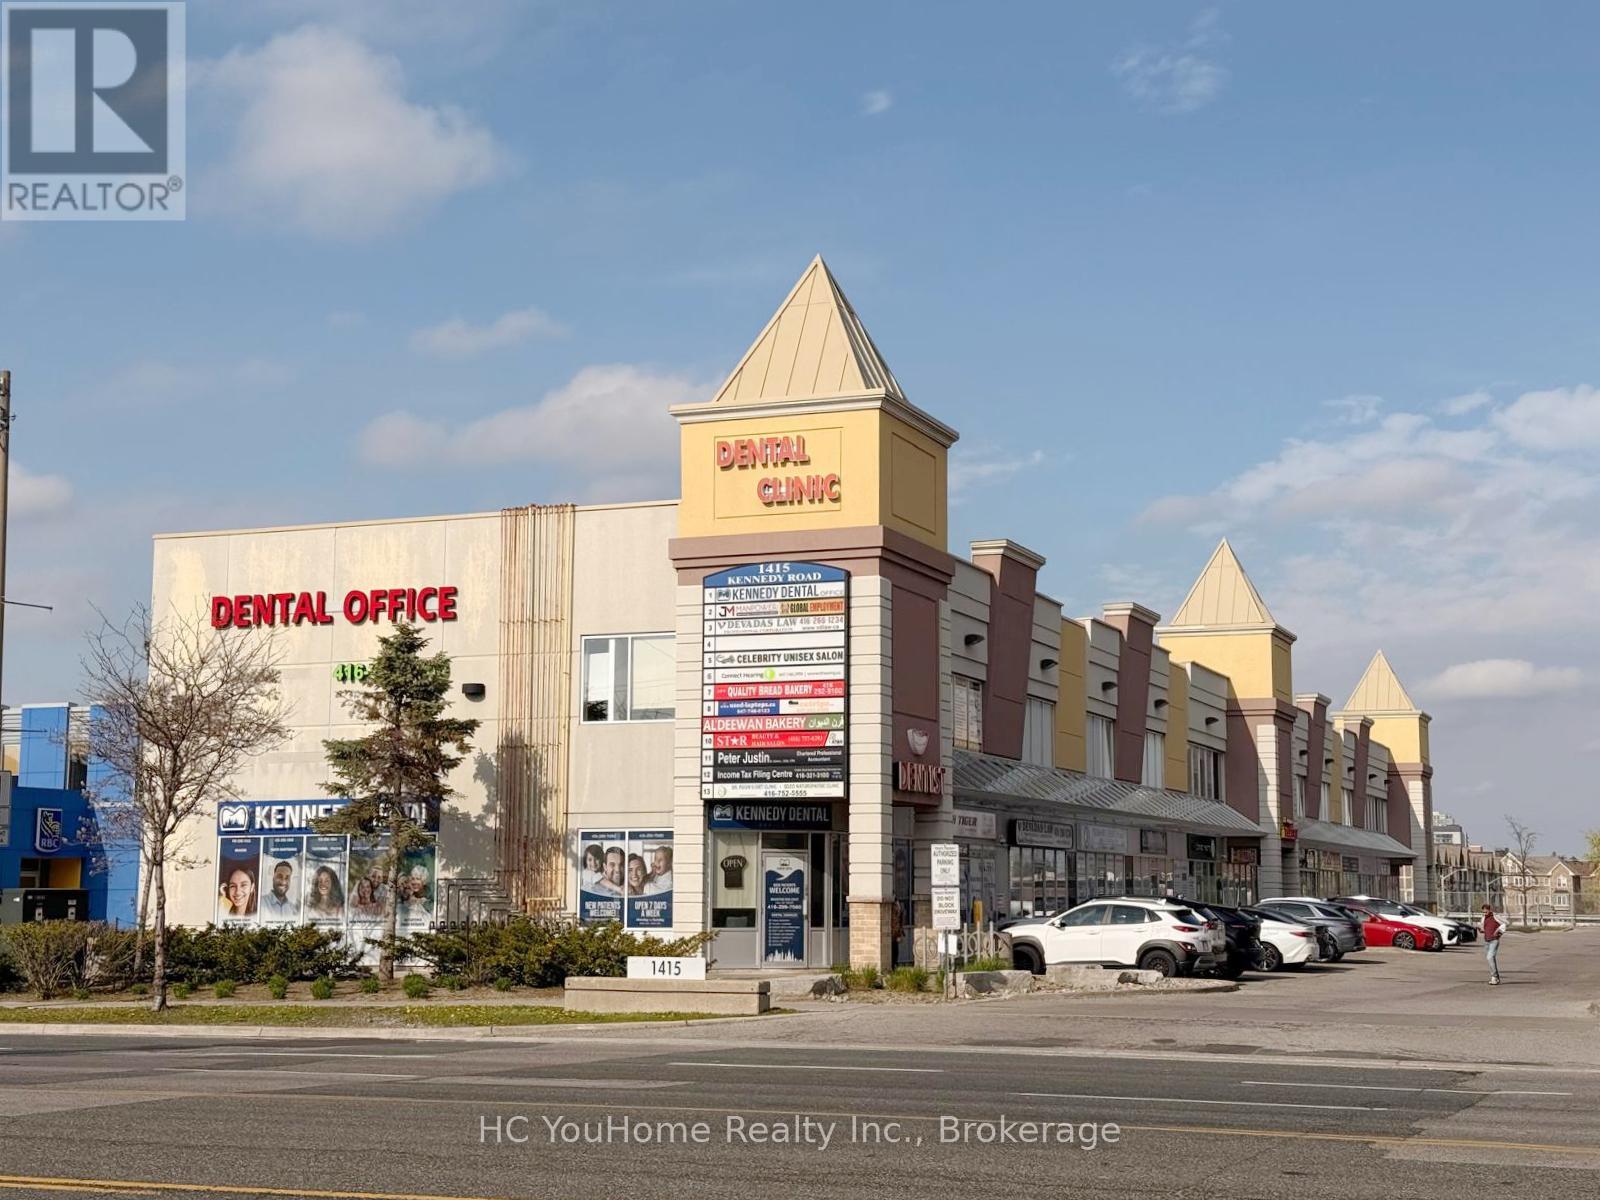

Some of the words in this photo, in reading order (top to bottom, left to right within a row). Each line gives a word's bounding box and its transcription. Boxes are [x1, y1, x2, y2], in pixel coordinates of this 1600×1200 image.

[717, 435, 810, 469] DENTAL
[757, 473, 840, 505] CLINIC
[759, 563, 790, 573] 1415
[727, 574, 786, 585] KENNEDY
[788, 572, 822, 581] ROAD
[732, 586, 779, 600] KENNEDY
[781, 585, 819, 598] DENTAL
[211, 591, 333, 630] DENTAL
[343, 586, 457, 625] OFFICE
[719, 606, 735, 617] JM
[727, 619, 773, 629] DEVADAS
[776, 618, 797, 628] LAW
[737, 653, 782, 664] CELEBRITY
[784, 652, 814, 662] UNISEX
[816, 651, 844, 660] SALON
[727, 686, 756, 697] QUALITY
[759, 685, 782, 696] BREAD
[784, 684, 812, 695] BAKERY
[766, 717, 806, 729] BAKERY
[718, 752, 740, 763] Peter
[743, 751, 770, 763] Justin
[717, 770, 740, 779] Income
[741, 770, 752, 778] Tax
[753, 770, 771, 779] Filing
[772, 770, 793, 778] Centre
[899, 761, 946, 795] DENTIST
[736, 805, 787, 821] KENNEDY
[789, 806, 829, 822] DENTAL
[41, 838, 58, 848] RBC
[723, 858, 744, 868] OPEN
[635, 901, 648, 910] OPEN
[654, 901, 667, 909] DAYS
[651, 960, 681, 976] 1415
